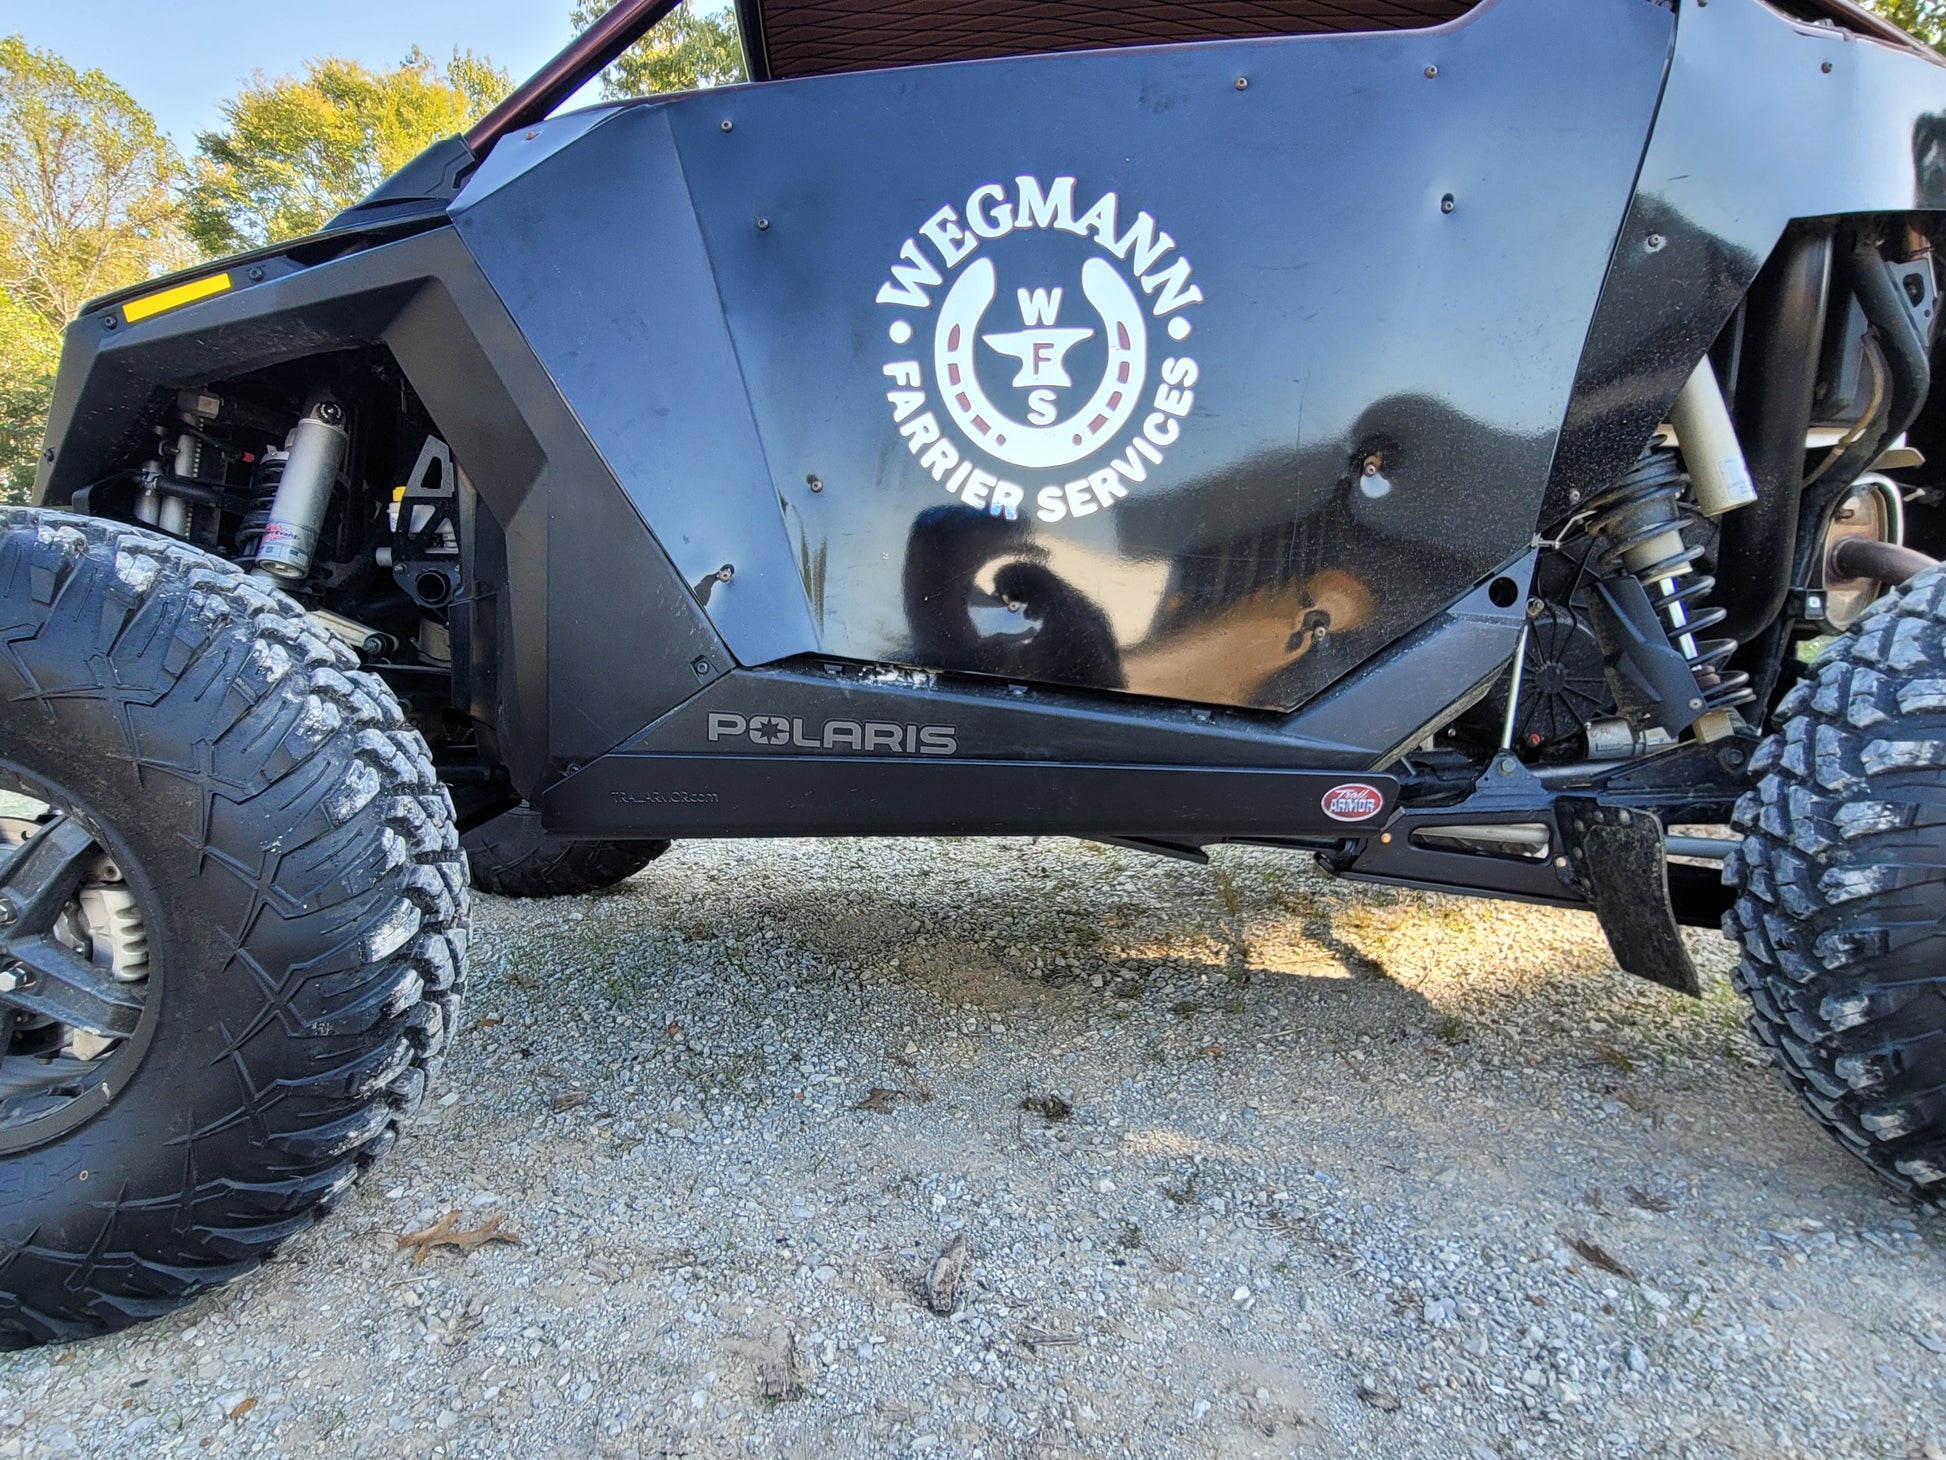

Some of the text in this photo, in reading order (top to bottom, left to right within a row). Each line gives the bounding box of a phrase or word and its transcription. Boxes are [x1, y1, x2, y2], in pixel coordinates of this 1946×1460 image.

[876, 175, 1204, 316] WEGMANN
[1017, 287, 1063, 326] W
[1033, 342, 1055, 375] F
[1027, 389, 1058, 425] S
[882, 357, 1199, 523] FARRIER SERVICES
[708, 711, 958, 756] POLARIS
[1329, 798, 1376, 812] ARMOR
